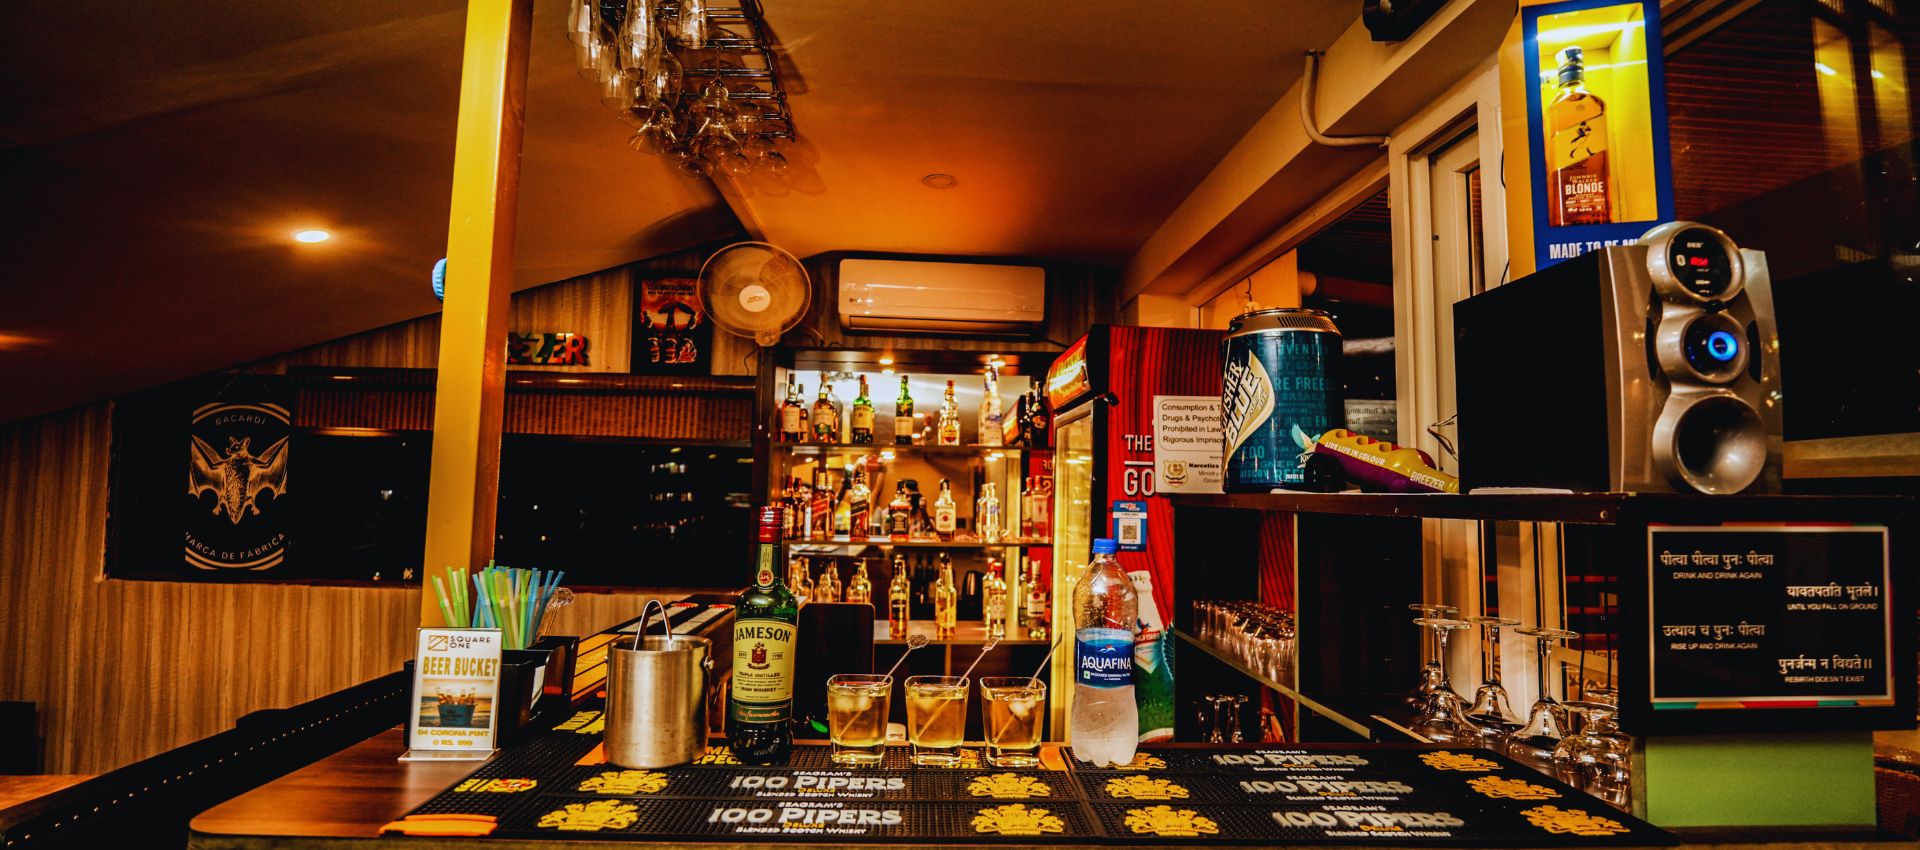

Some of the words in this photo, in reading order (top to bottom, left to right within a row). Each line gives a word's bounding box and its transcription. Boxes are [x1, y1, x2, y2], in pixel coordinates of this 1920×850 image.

[1565, 181, 1604, 195] BLONDE
[1549, 242, 1582, 260] MADE
[1162, 403, 1208, 413] Consumption
[1226, 365, 1260, 449] BLUE
[1162, 414, 1183, 423] Drugs
[1162, 425, 1197, 433] Prohibited
[1124, 434, 1153, 451] THE
[1163, 436, 1194, 445] Rigorous
[1324, 440, 1338, 451] LIVE
[1338, 444, 1352, 455] LIFE
[1351, 449, 1359, 457] IN
[1358, 450, 1386, 466] COLOUR
[1409, 471, 1445, 489] BREEZER
[185, 531, 216, 557] MARCA
[221, 551, 235, 560] DE
[1660, 550, 1688, 566] पीत्वा
[1691, 550, 1719, 566] पीत्वा
[1746, 550, 1774, 566] पीत्वा
[1673, 572, 1696, 580] DRINK
[1697, 572, 1714, 580] AND
[1714, 572, 1738, 580] DRINK
[1738, 572, 1763, 580] AGAIN
[735, 626, 791, 643] JAMESON
[1737, 620, 1766, 636] पीत्वा
[449, 635, 491, 644] SQUARE
[423, 656, 452, 675] BEER
[454, 657, 498, 677] BUCKET
[1081, 655, 1132, 672] AQUAFINA
[430, 729, 467, 737] CORONA
[1212, 754, 1265, 766] 100
[1264, 754, 1369, 766] PIPERS
[730, 775, 789, 789] 100
[793, 776, 905, 791] PIPERS
[1239, 780, 1298, 794] 100
[1296, 780, 1414, 794] PIPERS
[778, 801, 844, 809] SEAGRAM'S
[707, 807, 774, 824] 100
[778, 808, 903, 826] PIPERS
[1271, 811, 1338, 828] 100
[1334, 811, 1465, 828] PIPERS
[735, 826, 781, 834] BLENDED
[825, 827, 867, 835] WHISKY
